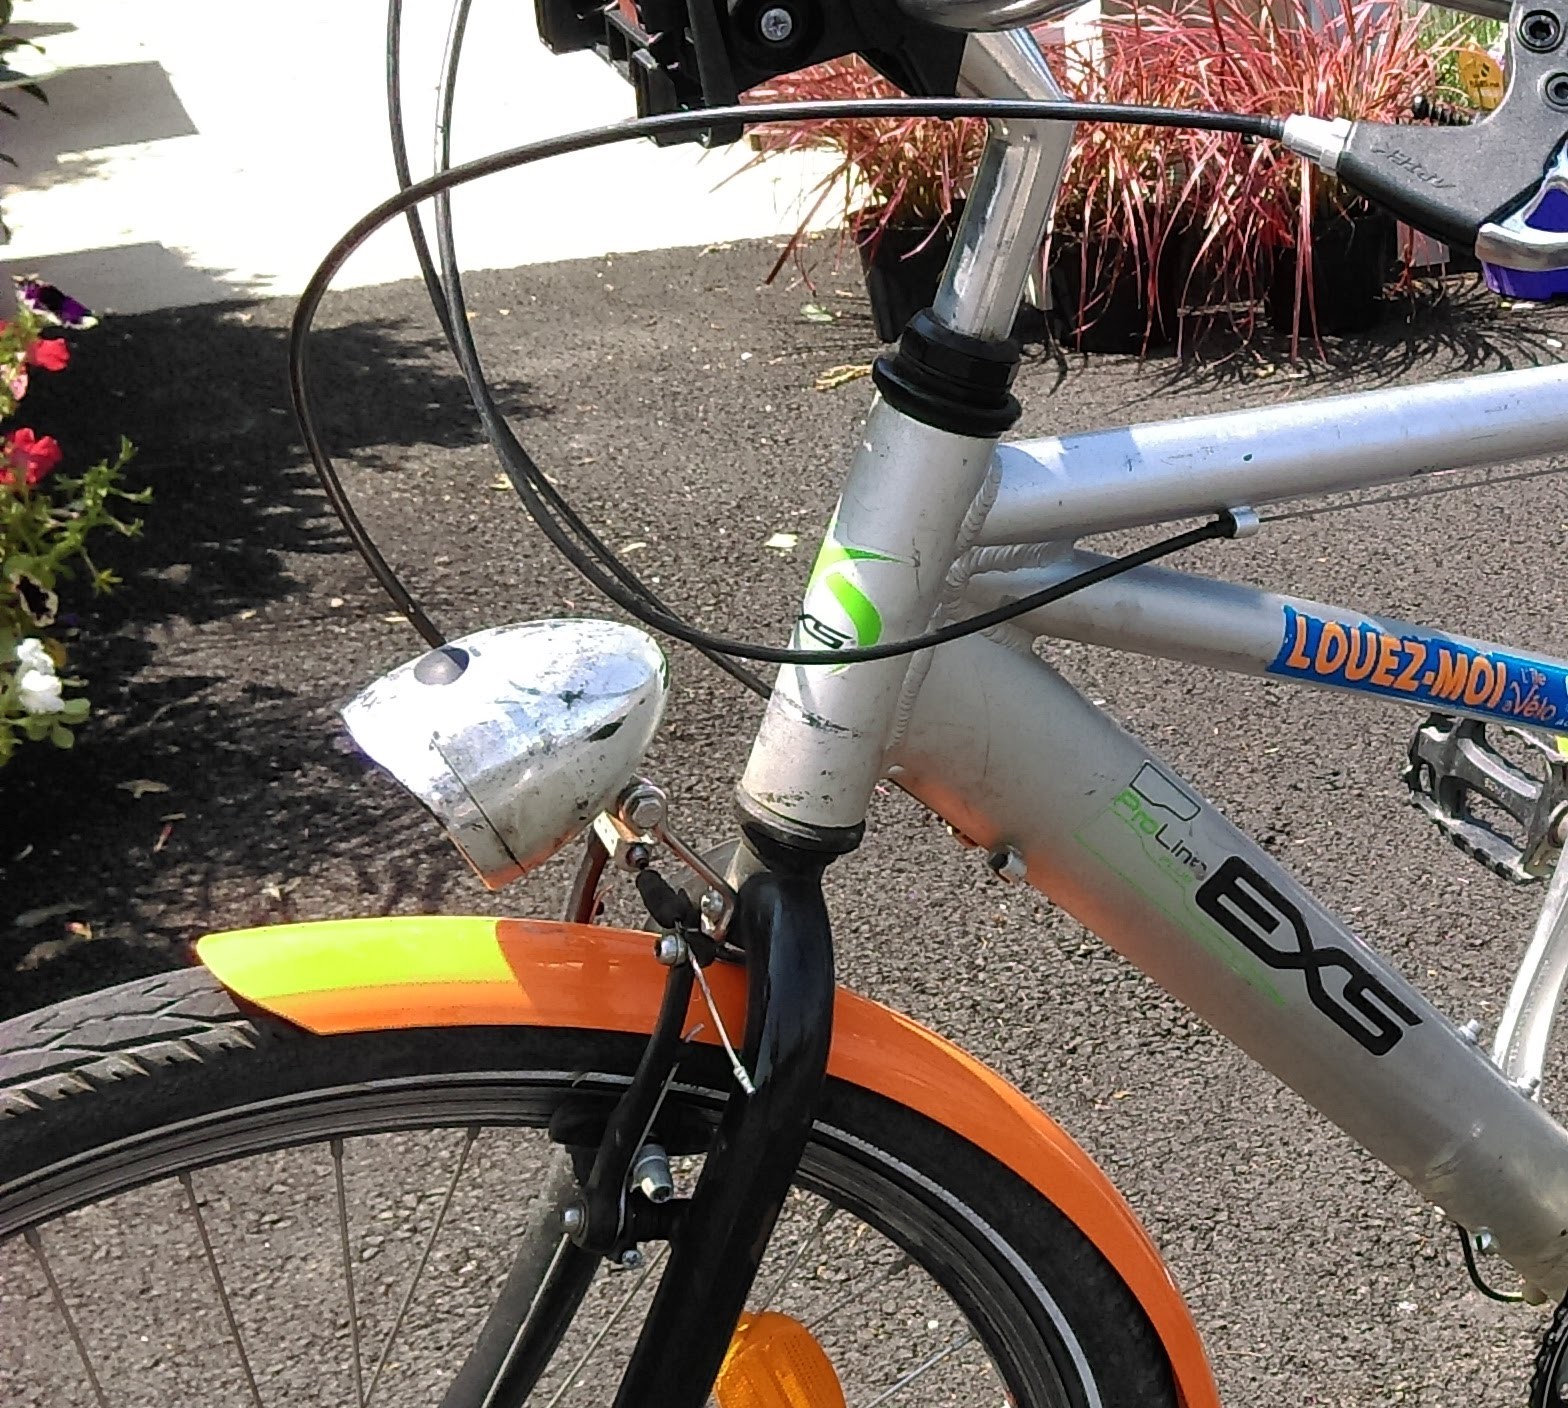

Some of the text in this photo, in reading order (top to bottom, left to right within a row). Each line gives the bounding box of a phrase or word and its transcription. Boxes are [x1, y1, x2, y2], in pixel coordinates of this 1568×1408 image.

[1285, 615, 1507, 709] LOUEZ-MOI
[1511, 681, 1557, 721] Vélo
[1195, 855, 1423, 1056] EXS
